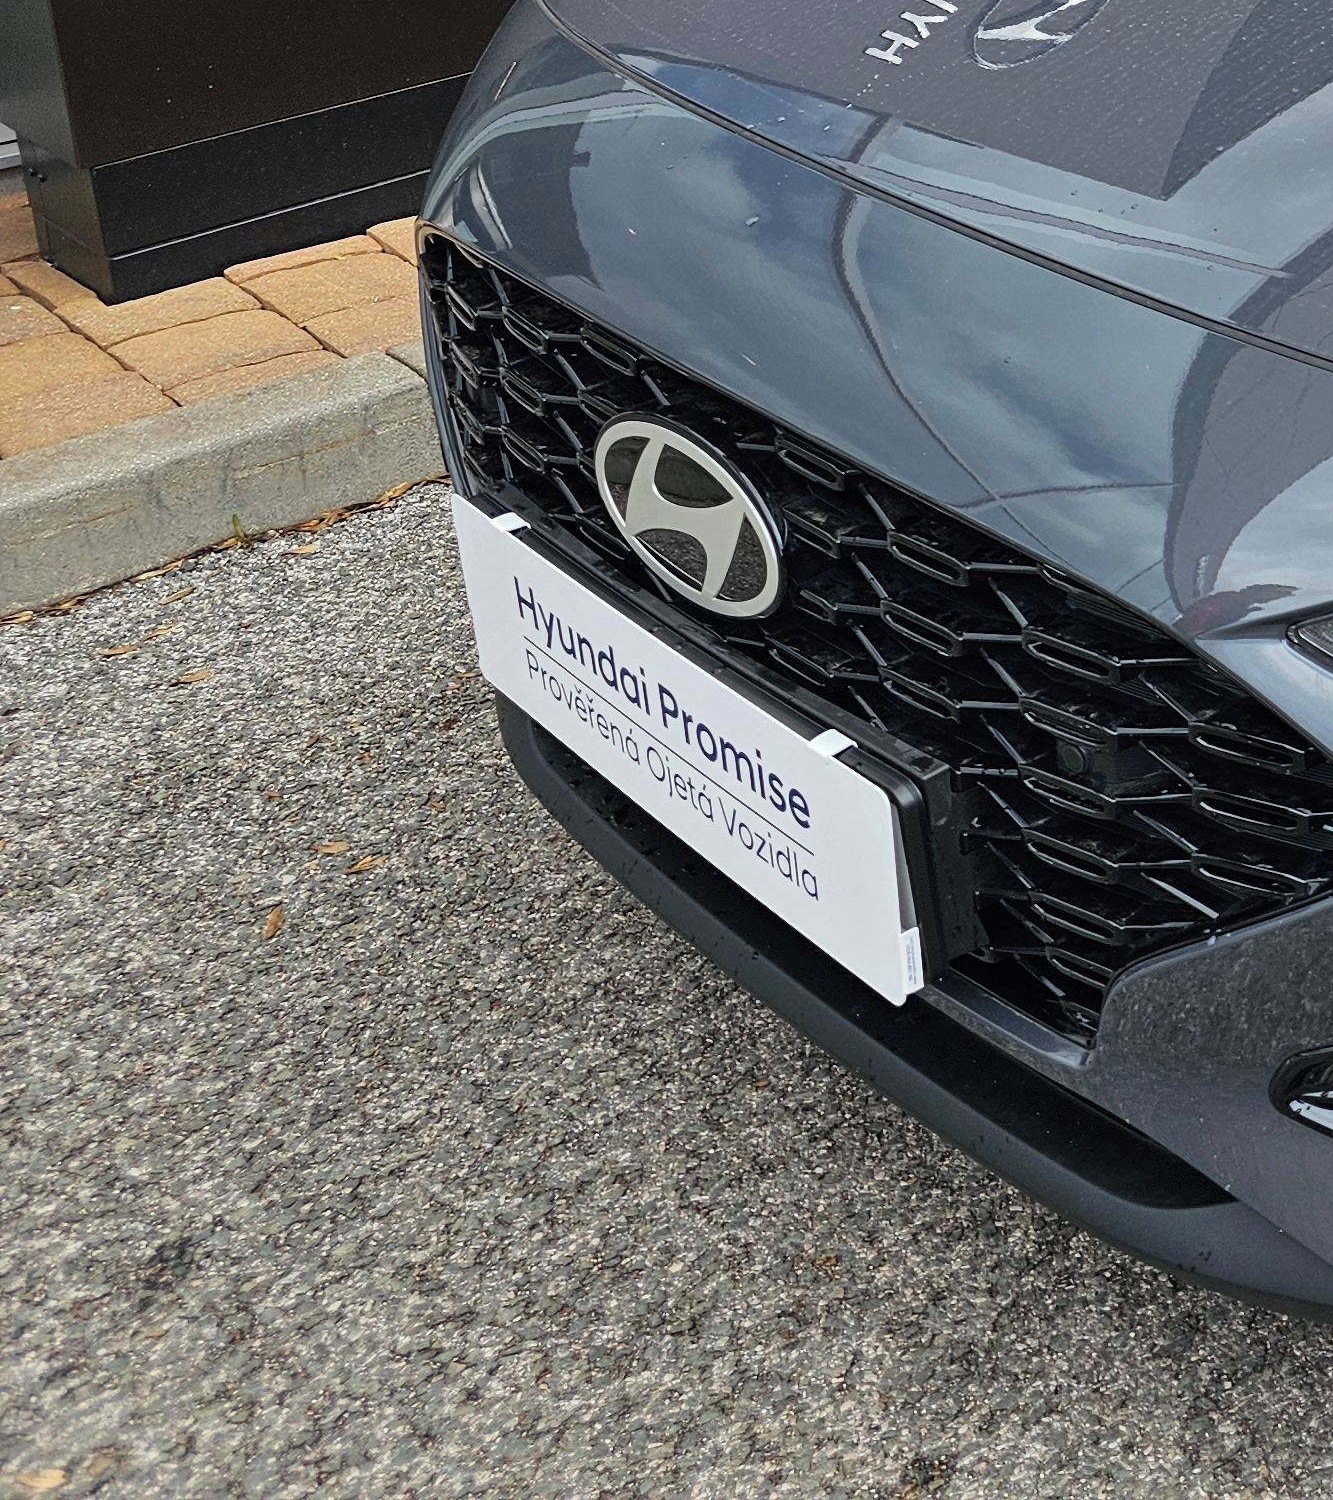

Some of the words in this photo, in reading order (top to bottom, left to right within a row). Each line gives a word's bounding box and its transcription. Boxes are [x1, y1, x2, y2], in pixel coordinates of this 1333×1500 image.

[513, 574, 652, 717] Hyundai
[659, 683, 812, 831] Promise
[526, 648, 640, 765] Prověřená
[646, 744, 714, 823] Ojetá
[718, 796, 820, 902] Vozidla
